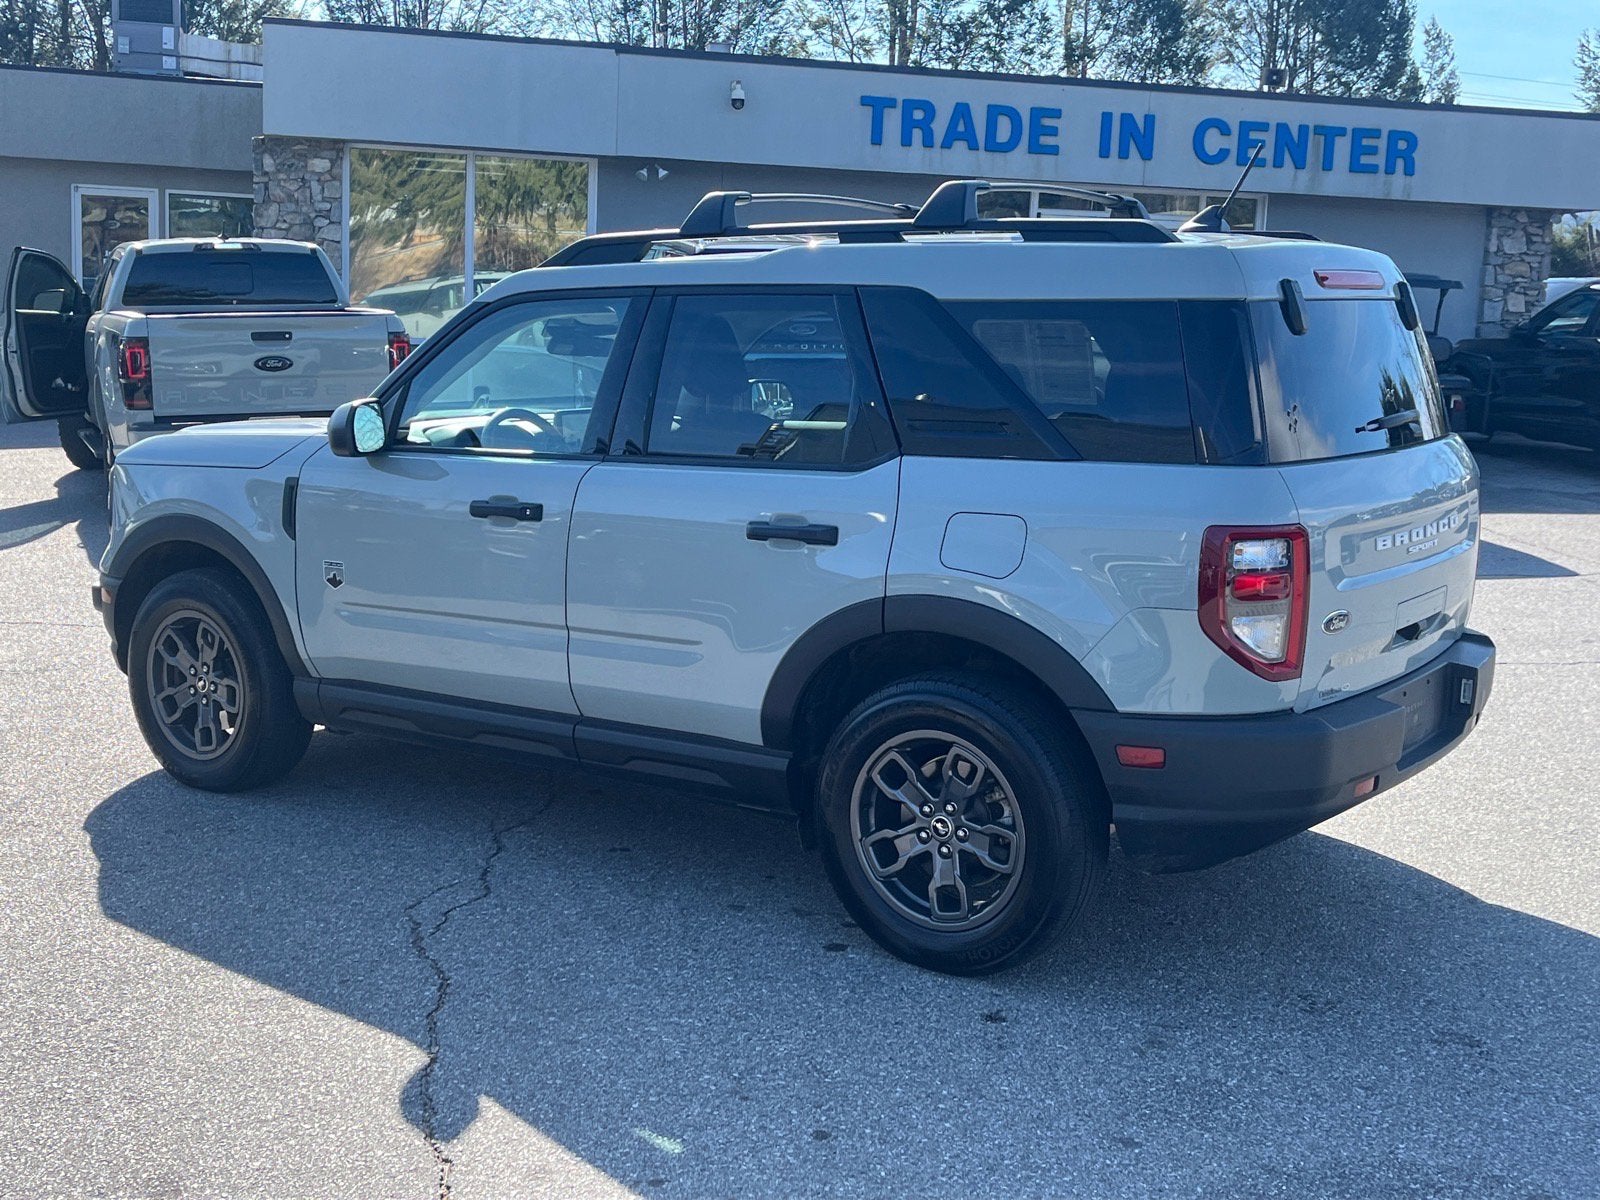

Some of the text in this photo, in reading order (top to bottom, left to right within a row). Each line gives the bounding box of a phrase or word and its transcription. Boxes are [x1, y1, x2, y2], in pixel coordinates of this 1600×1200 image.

[860, 95, 1418, 176] TRADE IN CENTER
[1375, 511, 1459, 551] BRONCO
[1407, 538, 1439, 555] SPORT
